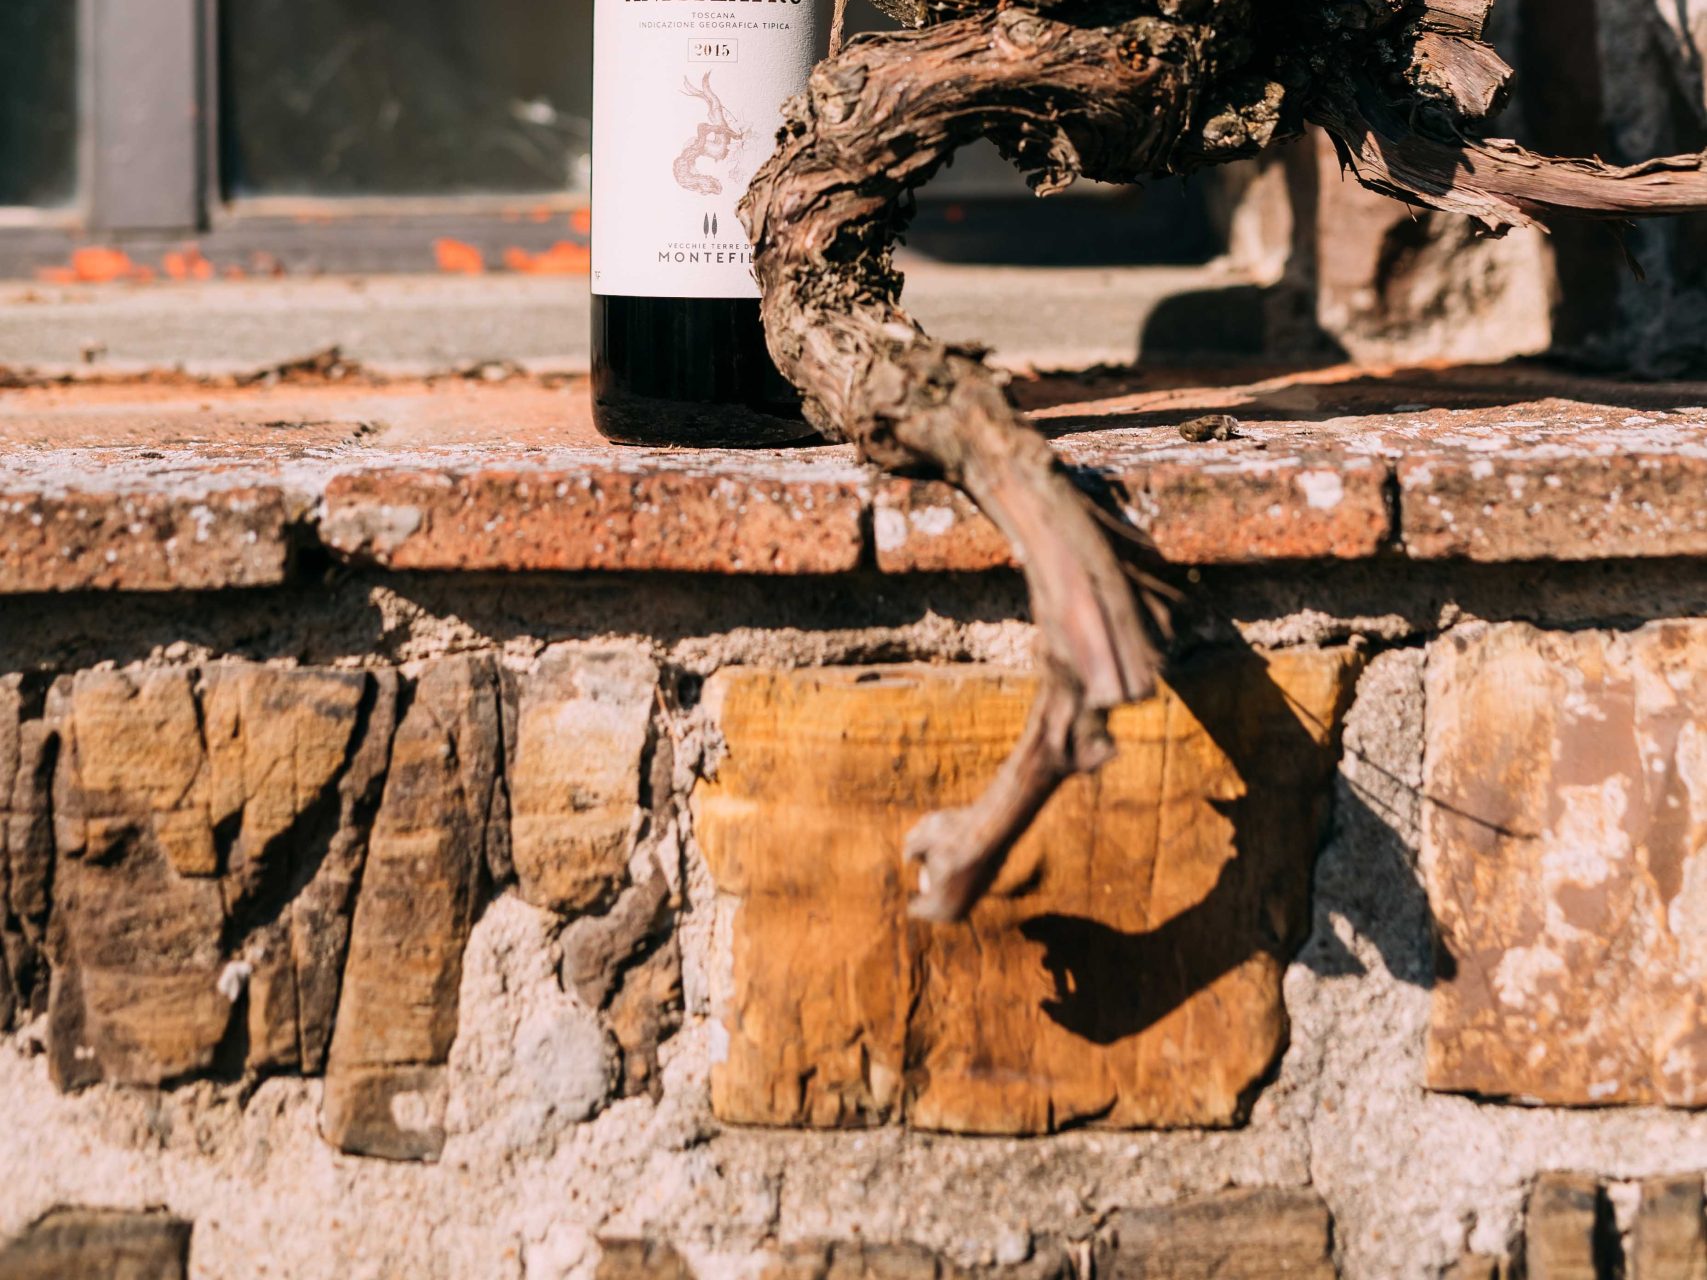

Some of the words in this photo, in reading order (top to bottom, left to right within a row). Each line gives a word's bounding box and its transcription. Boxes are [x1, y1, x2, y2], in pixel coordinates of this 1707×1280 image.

[691, 11, 736, 19] TOSCANA
[638, 21, 695, 29] INDICAZIONE
[698, 21, 759, 30] GEOGRAFICA
[762, 22, 790, 30] TIPICA
[694, 43, 730, 57] 2015
[667, 242, 707, 250] VECCHIE
[658, 252, 754, 264] MONTEFIL
